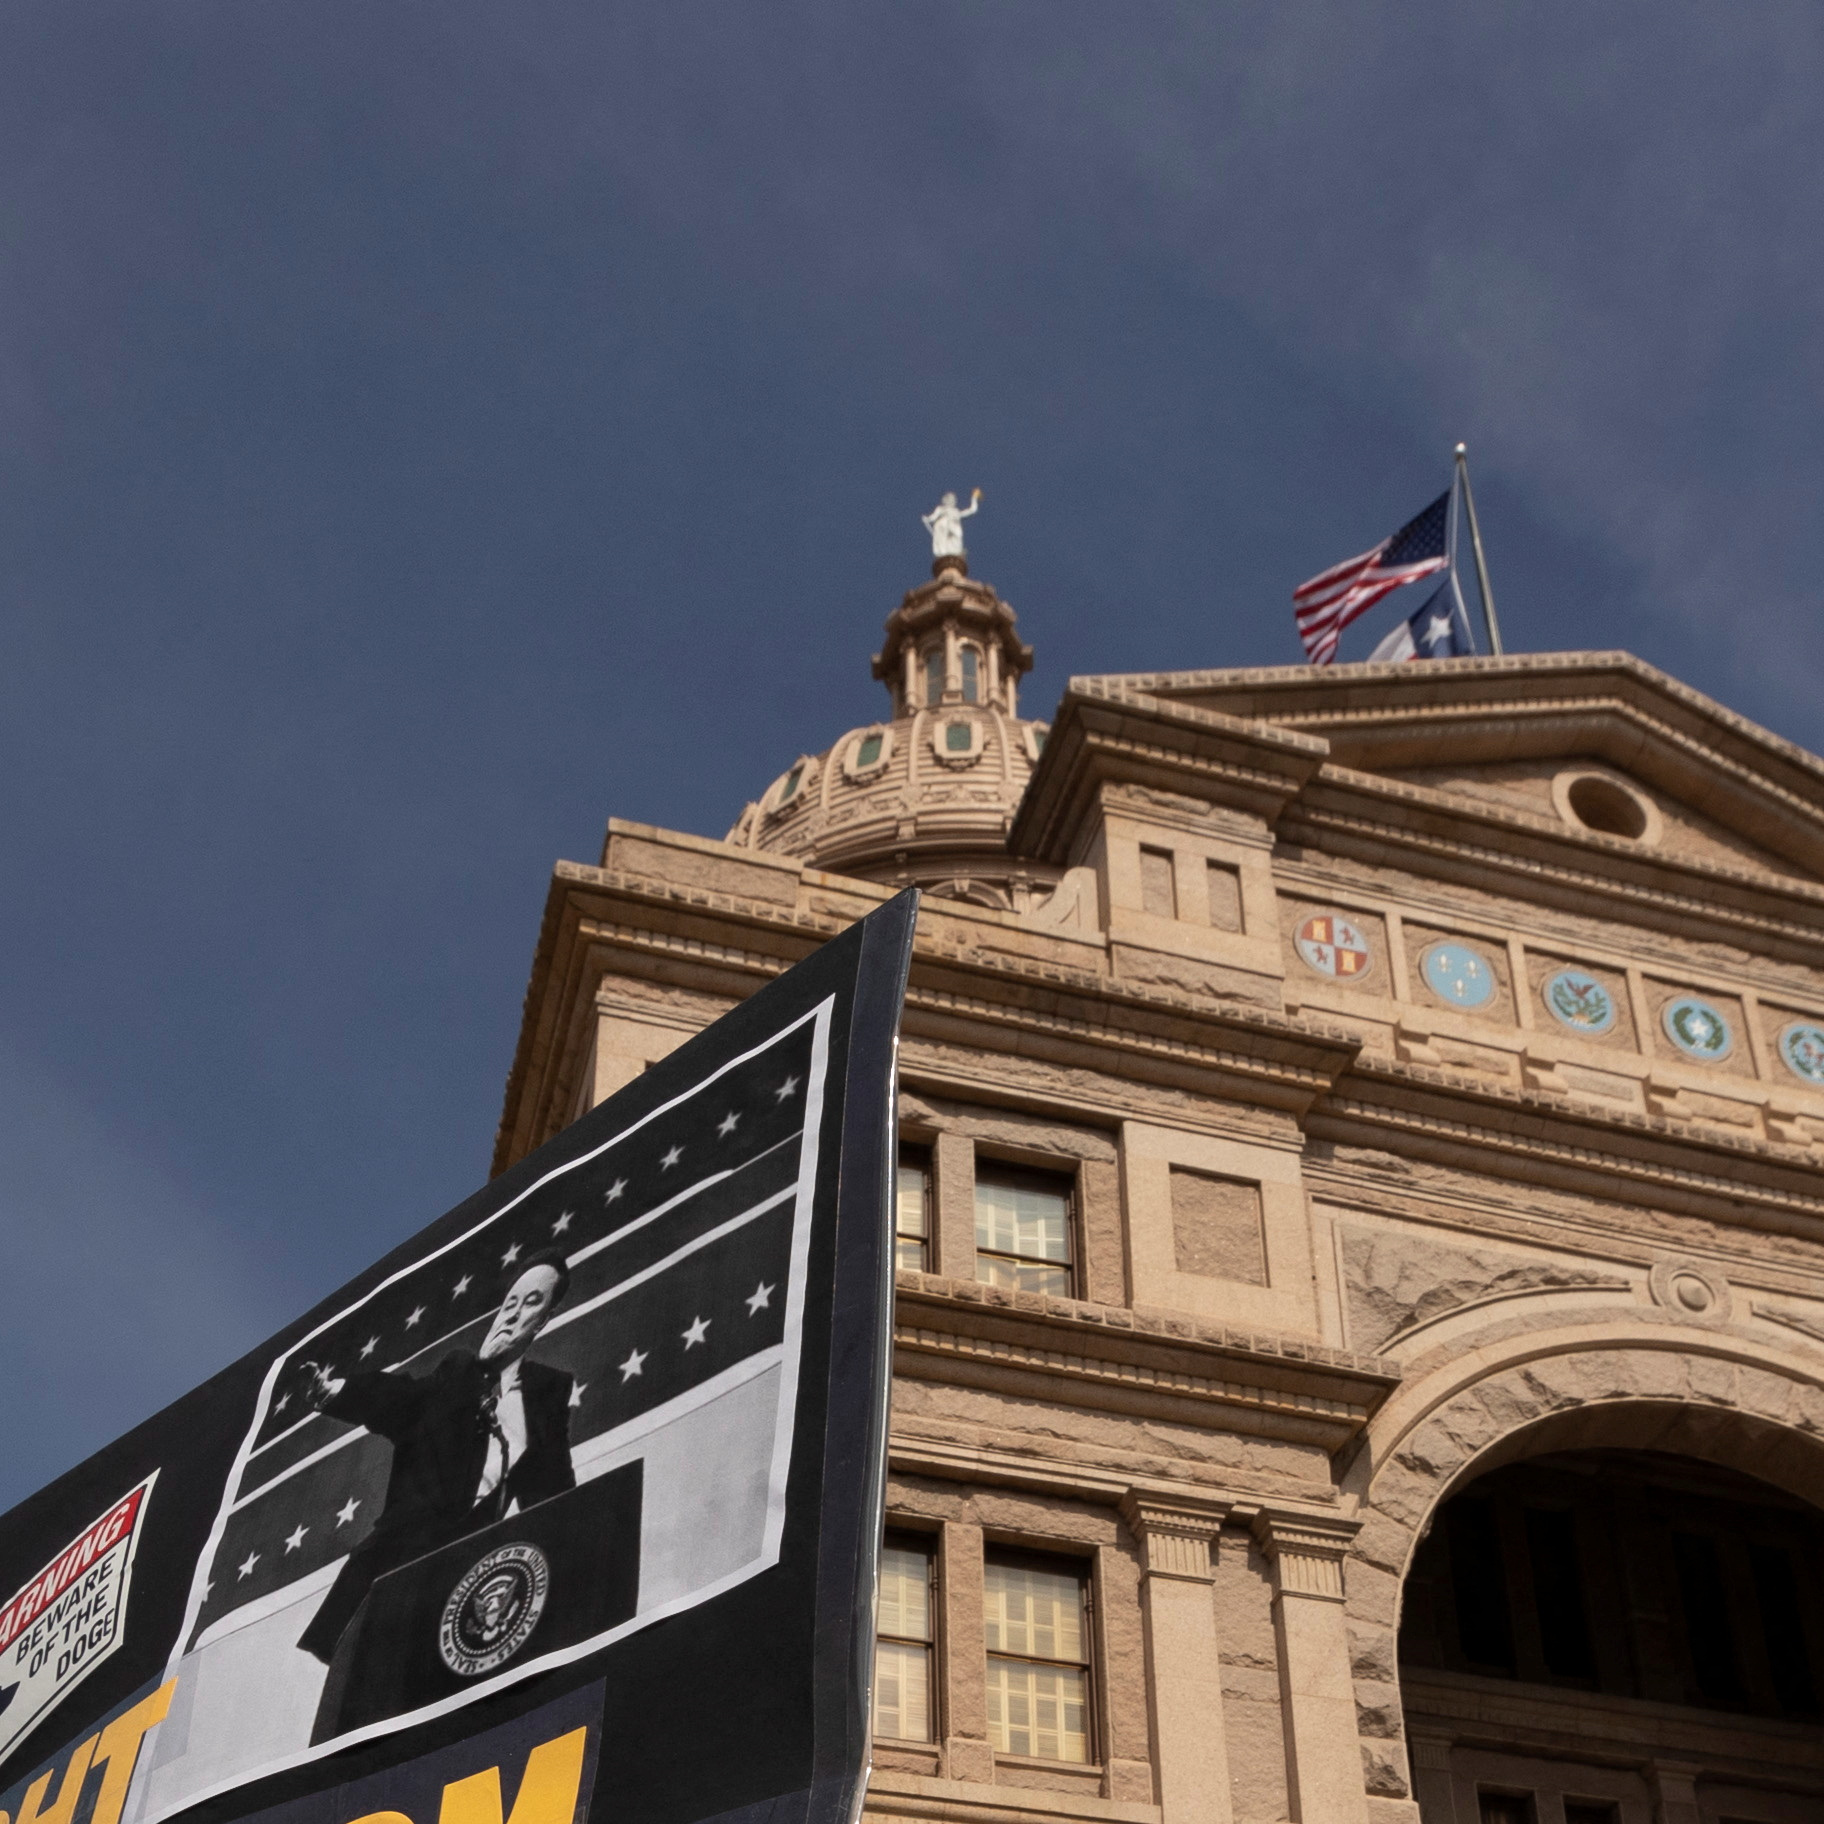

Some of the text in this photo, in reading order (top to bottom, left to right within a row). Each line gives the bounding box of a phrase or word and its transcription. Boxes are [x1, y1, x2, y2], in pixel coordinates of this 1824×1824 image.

[16, 1552, 116, 1666] BEWARE
[444, 1555, 495, 1625] PRESIDENT
[529, 1551, 546, 1596] UNITED
[29, 1584, 110, 1678] OF THE
[56, 1608, 115, 1682] DOGE
[496, 1609, 539, 1661] STATES
